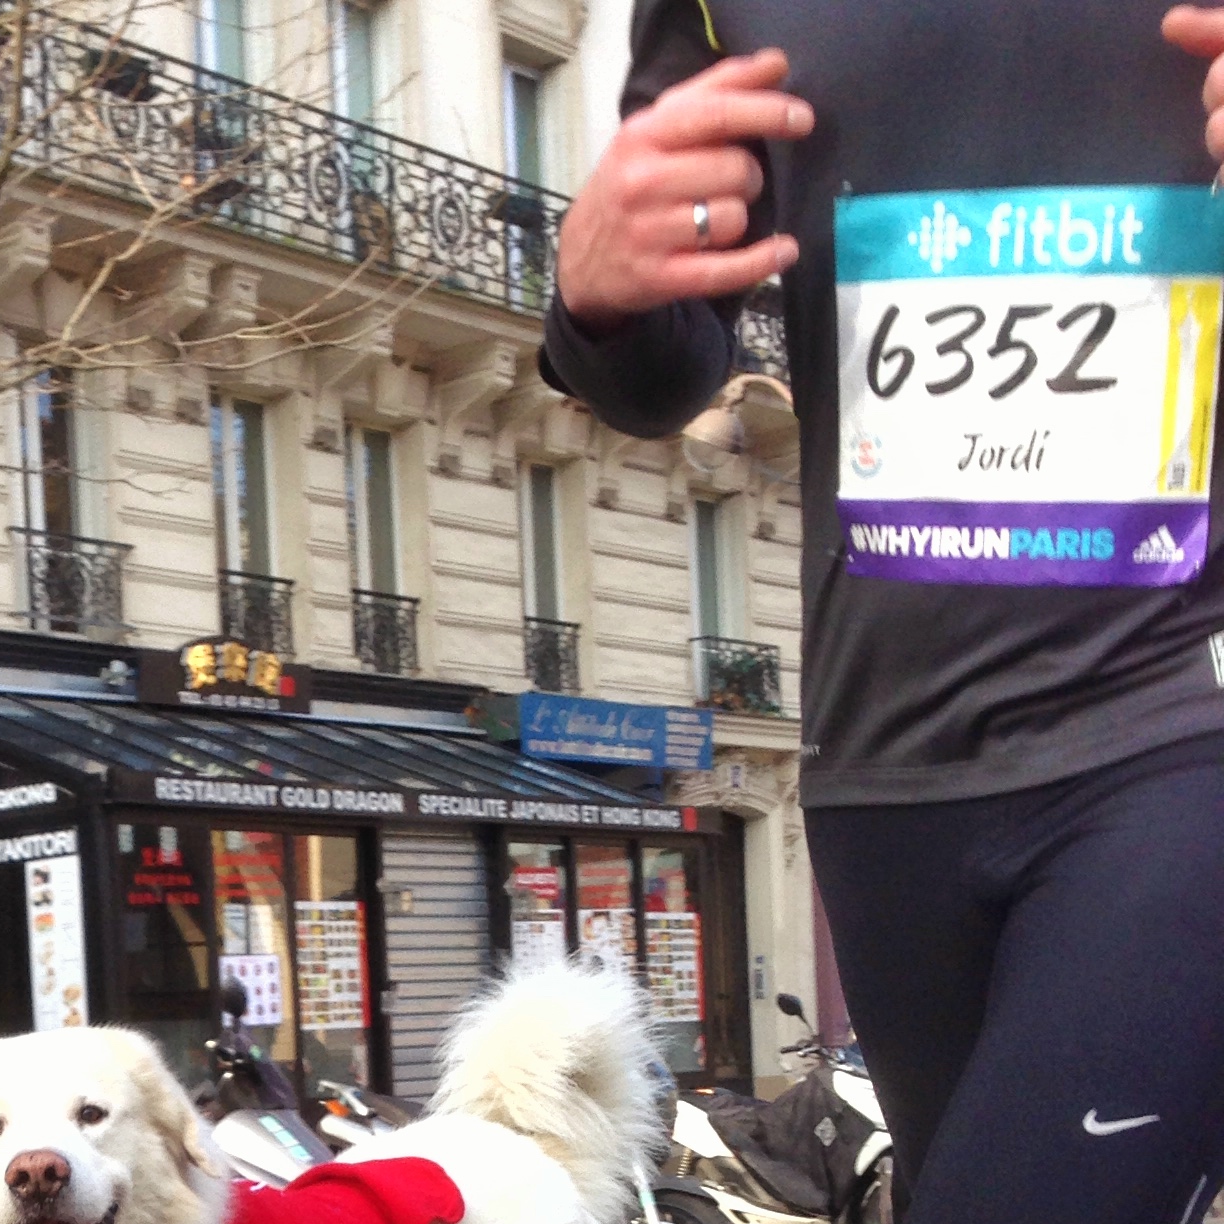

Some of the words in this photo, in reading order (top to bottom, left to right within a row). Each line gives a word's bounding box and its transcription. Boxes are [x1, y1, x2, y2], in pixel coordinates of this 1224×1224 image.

[986, 200, 1144, 268] fitbit
[866, 302, 1118, 401] 6352
[957, 429, 1051, 473] Jordi
[154, 777, 279, 807] RESTAURANT
[280, 785, 330, 810] GOLD
[332, 788, 405, 815] DRAGON
[418, 793, 507, 819] SPECIALITE
[510, 799, 578, 823] JAPONAIS
[580, 803, 600, 824] ET
[601, 805, 642, 827] HONG
[642, 808, 682, 829] KONG
